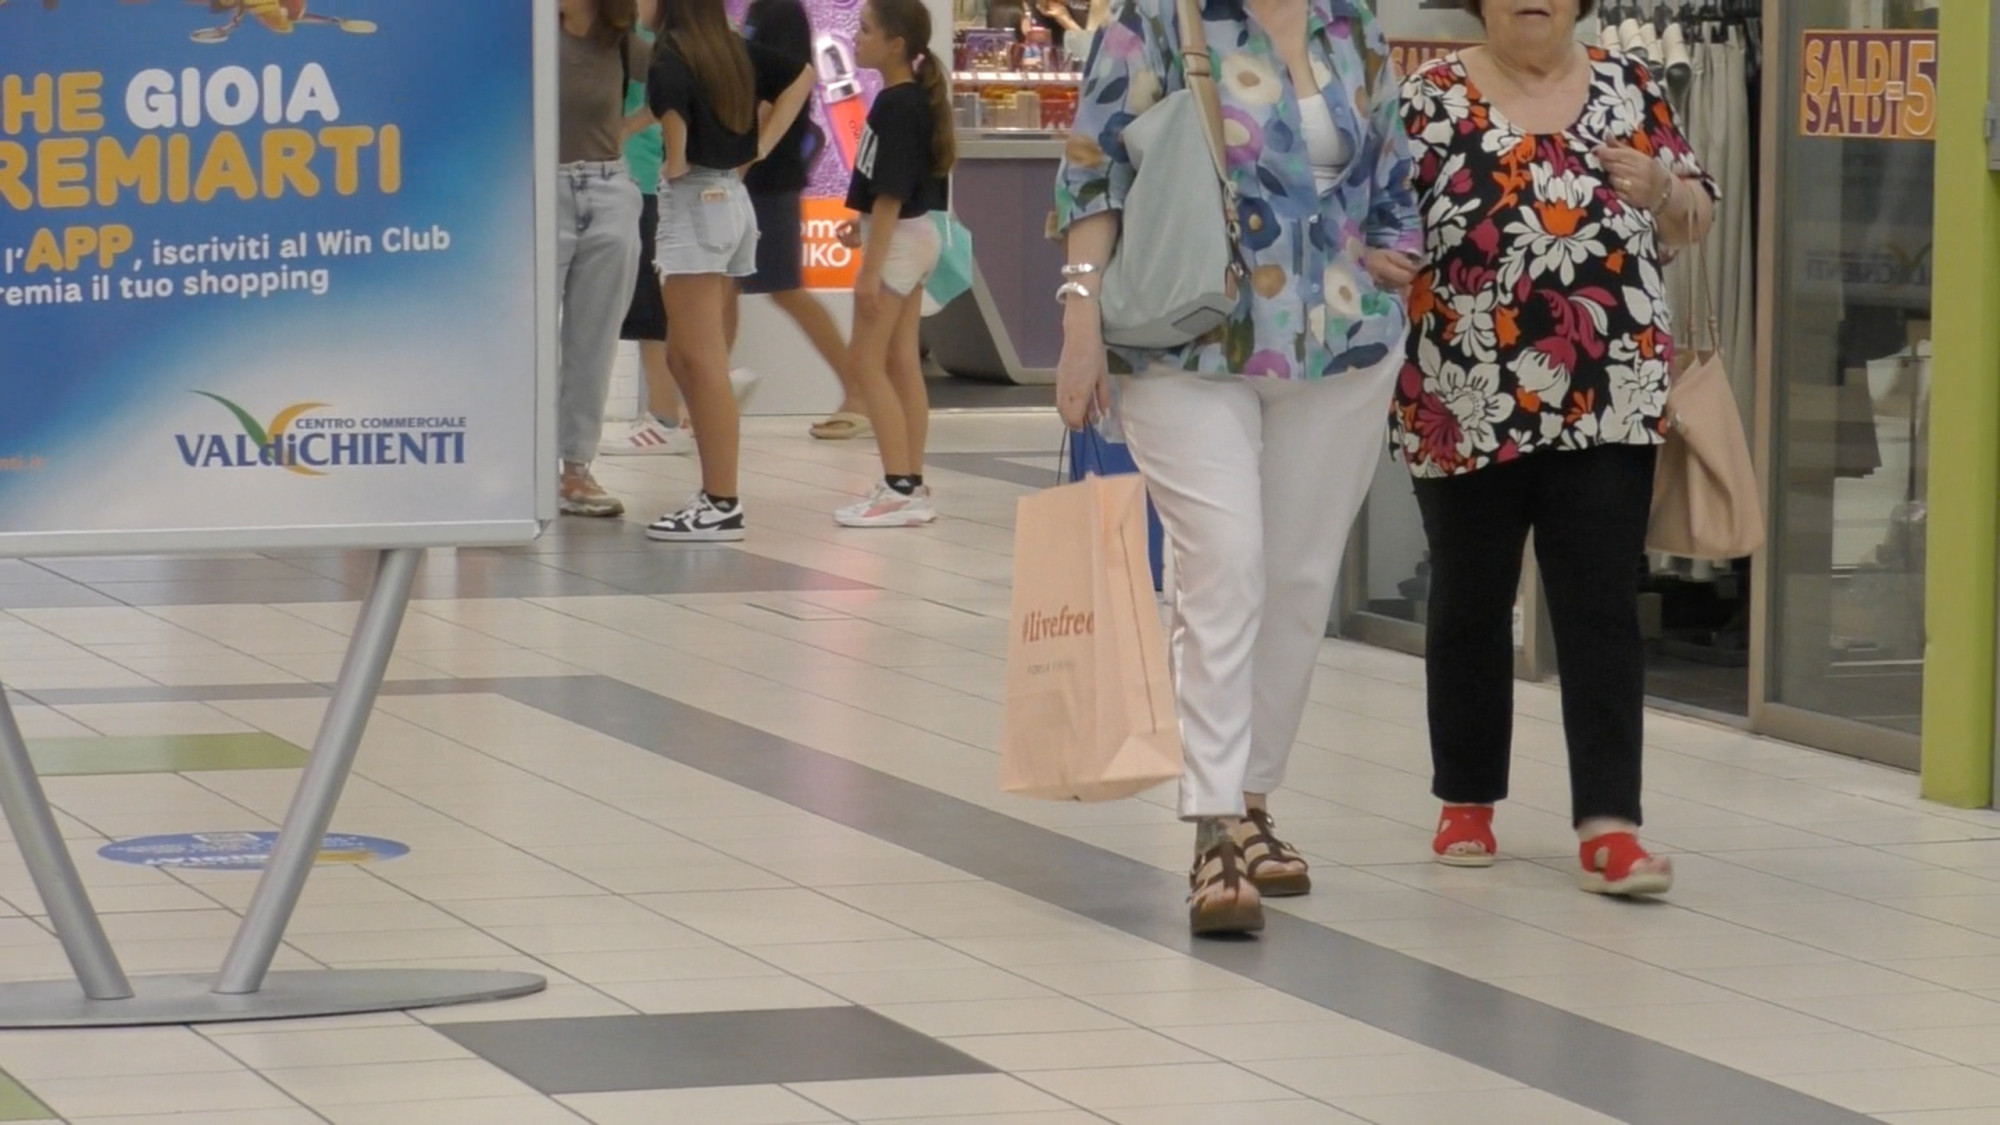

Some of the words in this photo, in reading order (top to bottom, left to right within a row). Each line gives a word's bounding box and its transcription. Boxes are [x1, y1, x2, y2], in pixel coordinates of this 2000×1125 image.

[1805, 39, 1901, 97] SALDI
[3, 71, 104, 135] HE
[125, 62, 340, 130] GIOIA
[0, 123, 401, 211] REMIARTI
[152, 233, 270, 266] iscriviti
[279, 231, 308, 259] al
[316, 228, 372, 256] Win
[381, 224, 451, 252] Club
[92, 274, 109, 301] il
[119, 276, 173, 299] tuo
[183, 264, 329, 299] shopping
[295, 417, 355, 430] CENTRO
[361, 416, 467, 429] COMMERCIALE
